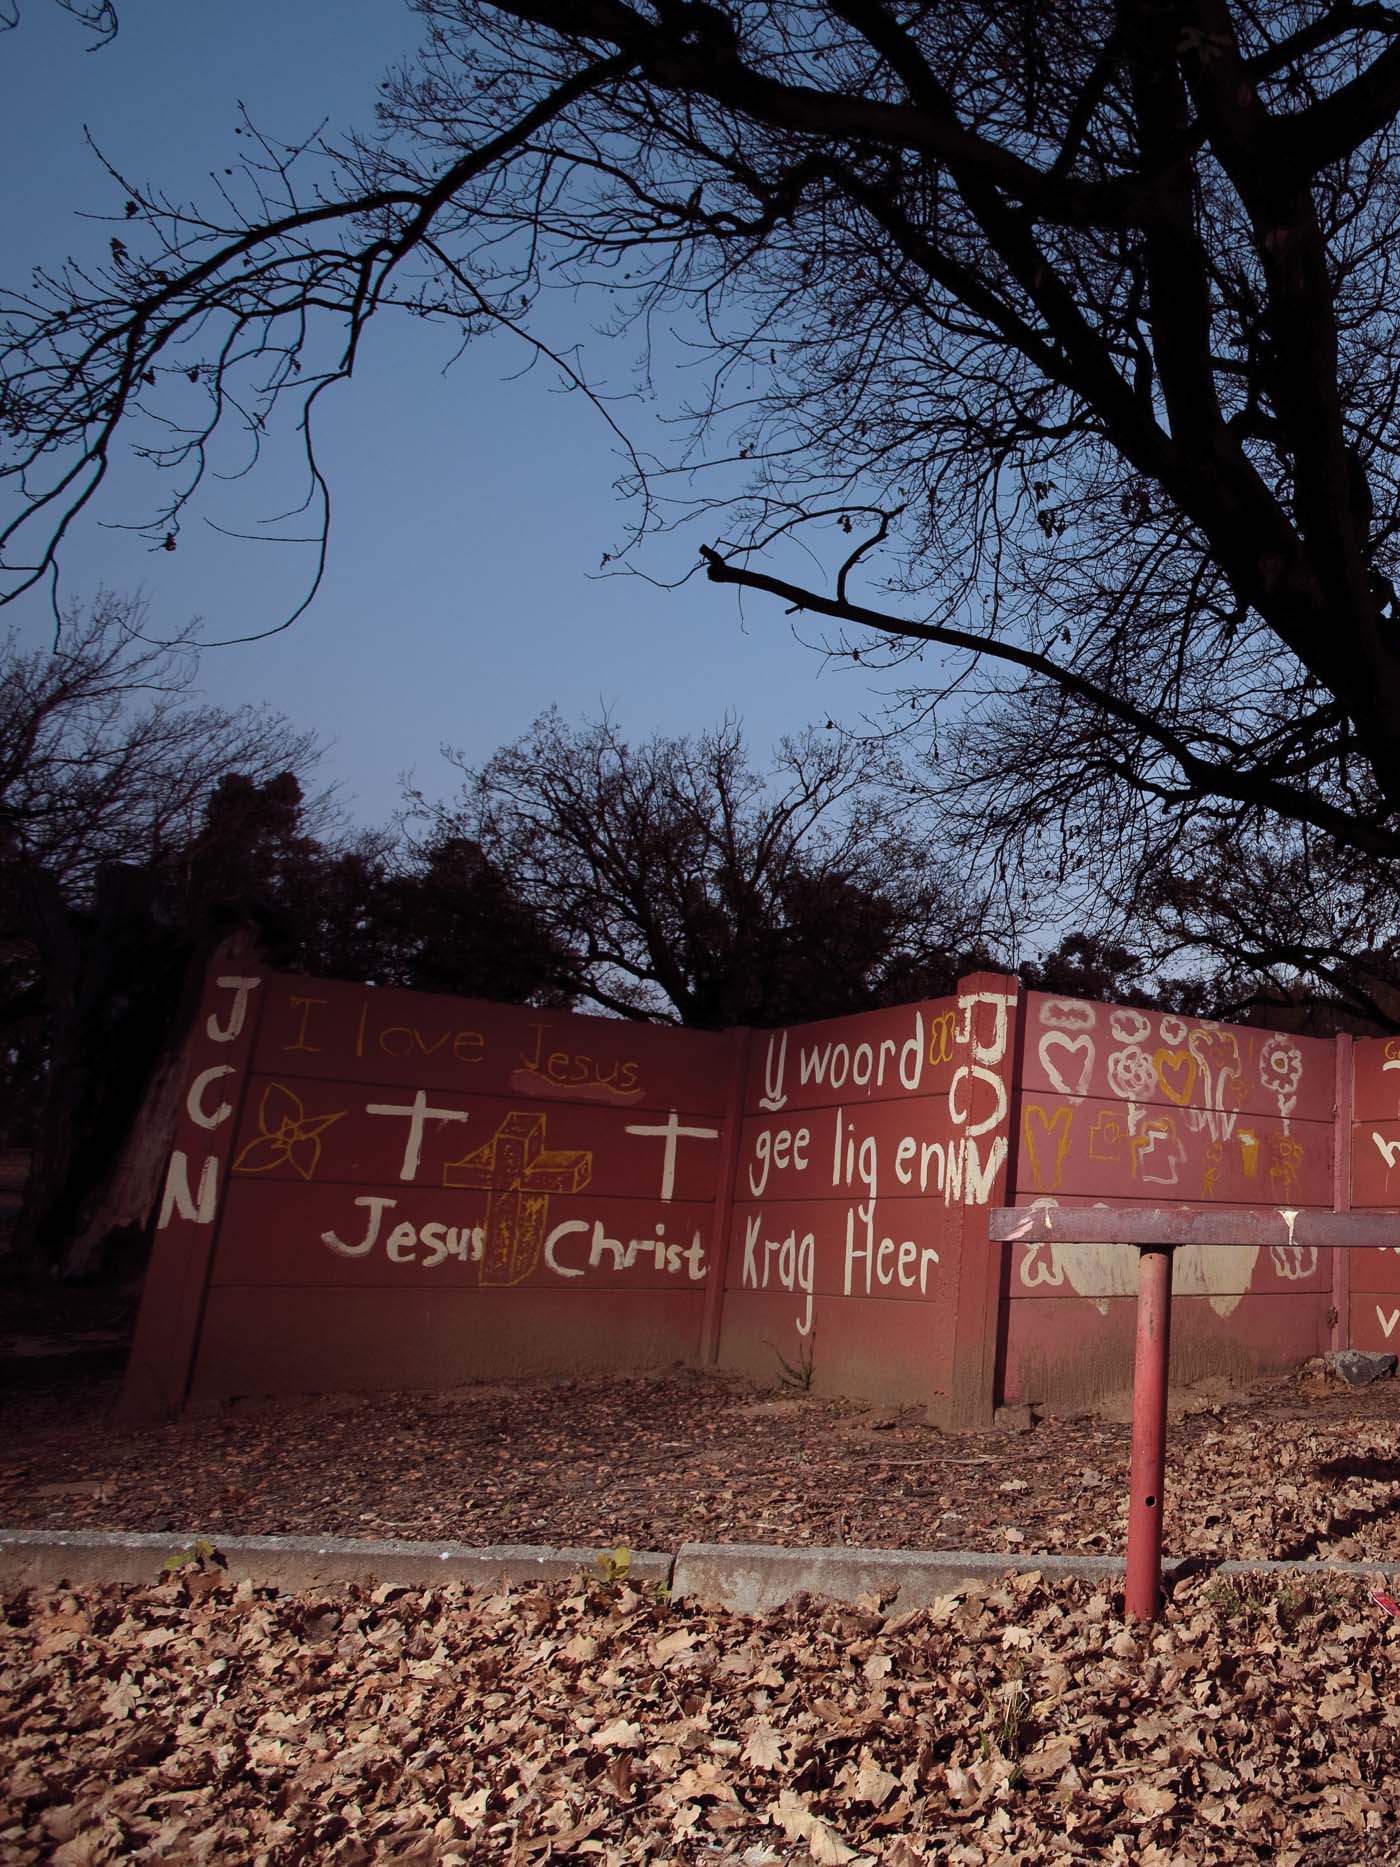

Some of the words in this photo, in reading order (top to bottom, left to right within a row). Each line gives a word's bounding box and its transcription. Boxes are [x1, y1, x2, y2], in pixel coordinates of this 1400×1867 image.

[283, 996, 326, 1051] I
[356, 1001, 485, 1062] love
[514, 1024, 640, 1086] Jesus
[800, 1010, 925, 1090] woord
[749, 1127, 811, 1198] gee
[832, 1106, 877, 1222] lig
[895, 1136, 946, 1192] en
[321, 1197, 484, 1267] Jesus
[545, 1221, 709, 1280] Christ
[742, 1212, 815, 1336] Krag
[843, 1207, 939, 1296] Heer
